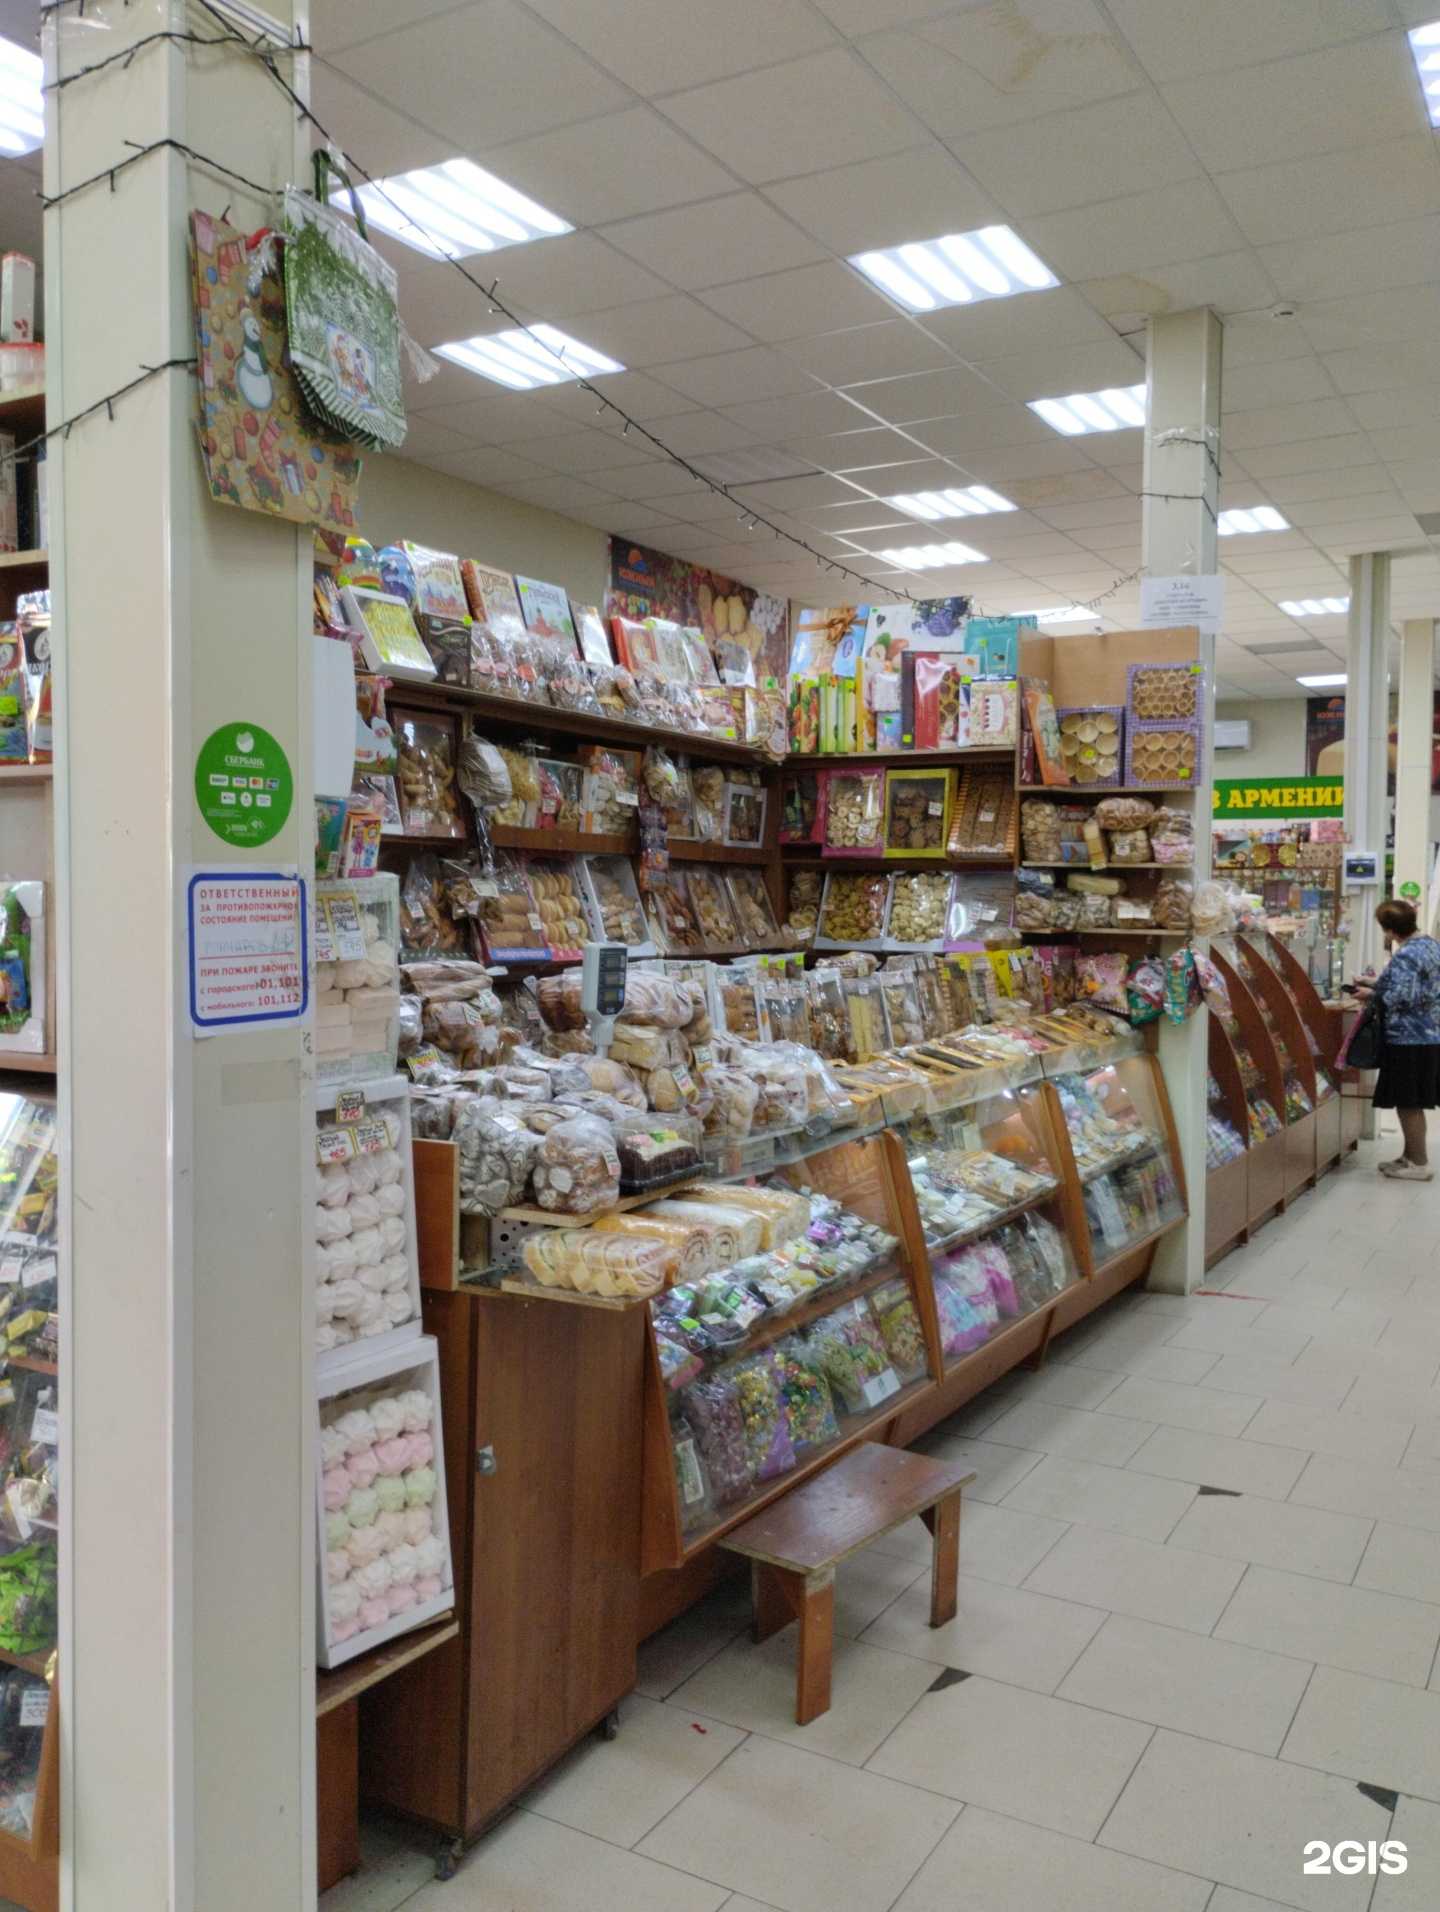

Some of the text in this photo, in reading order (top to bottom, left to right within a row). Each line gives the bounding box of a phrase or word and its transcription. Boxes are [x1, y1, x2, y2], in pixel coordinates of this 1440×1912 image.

[200, 887, 299, 898] ОТВЕТСТВЕННЫЙ
[200, 967, 220, 976] ПРИ
[222, 965, 257, 975] ПОЖАРЕ
